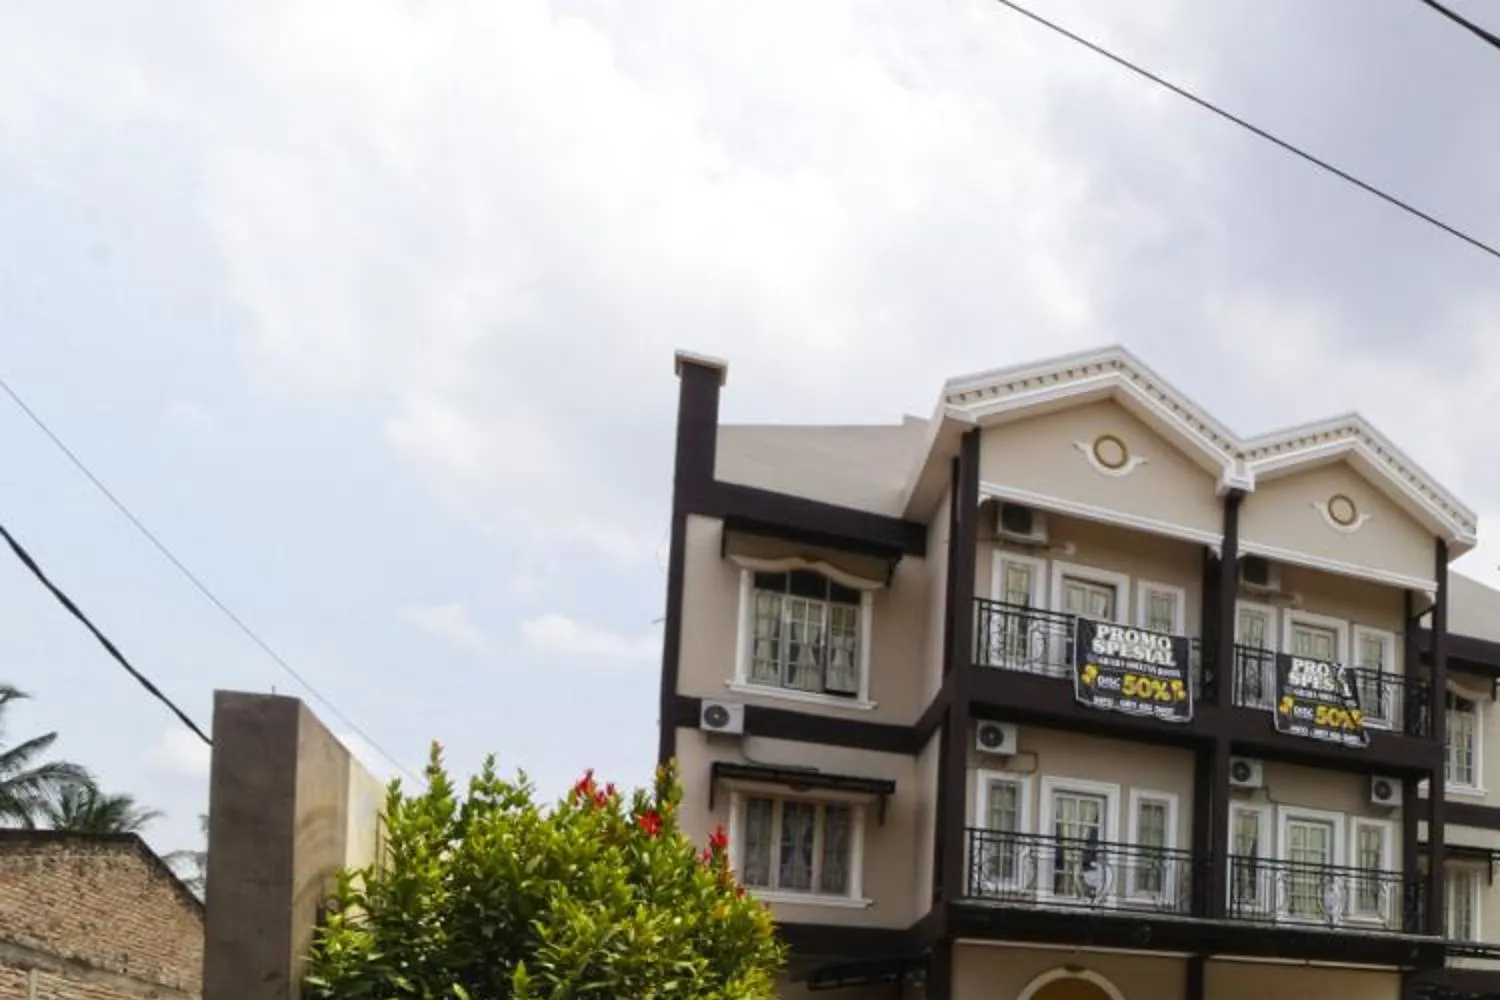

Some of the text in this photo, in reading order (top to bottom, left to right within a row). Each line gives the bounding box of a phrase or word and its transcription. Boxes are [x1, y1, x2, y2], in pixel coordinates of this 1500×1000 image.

[1096, 624, 1172, 650] PROMO
[1092, 638, 1177, 667] SPESIAL
[1121, 674, 1172, 702] 50%
